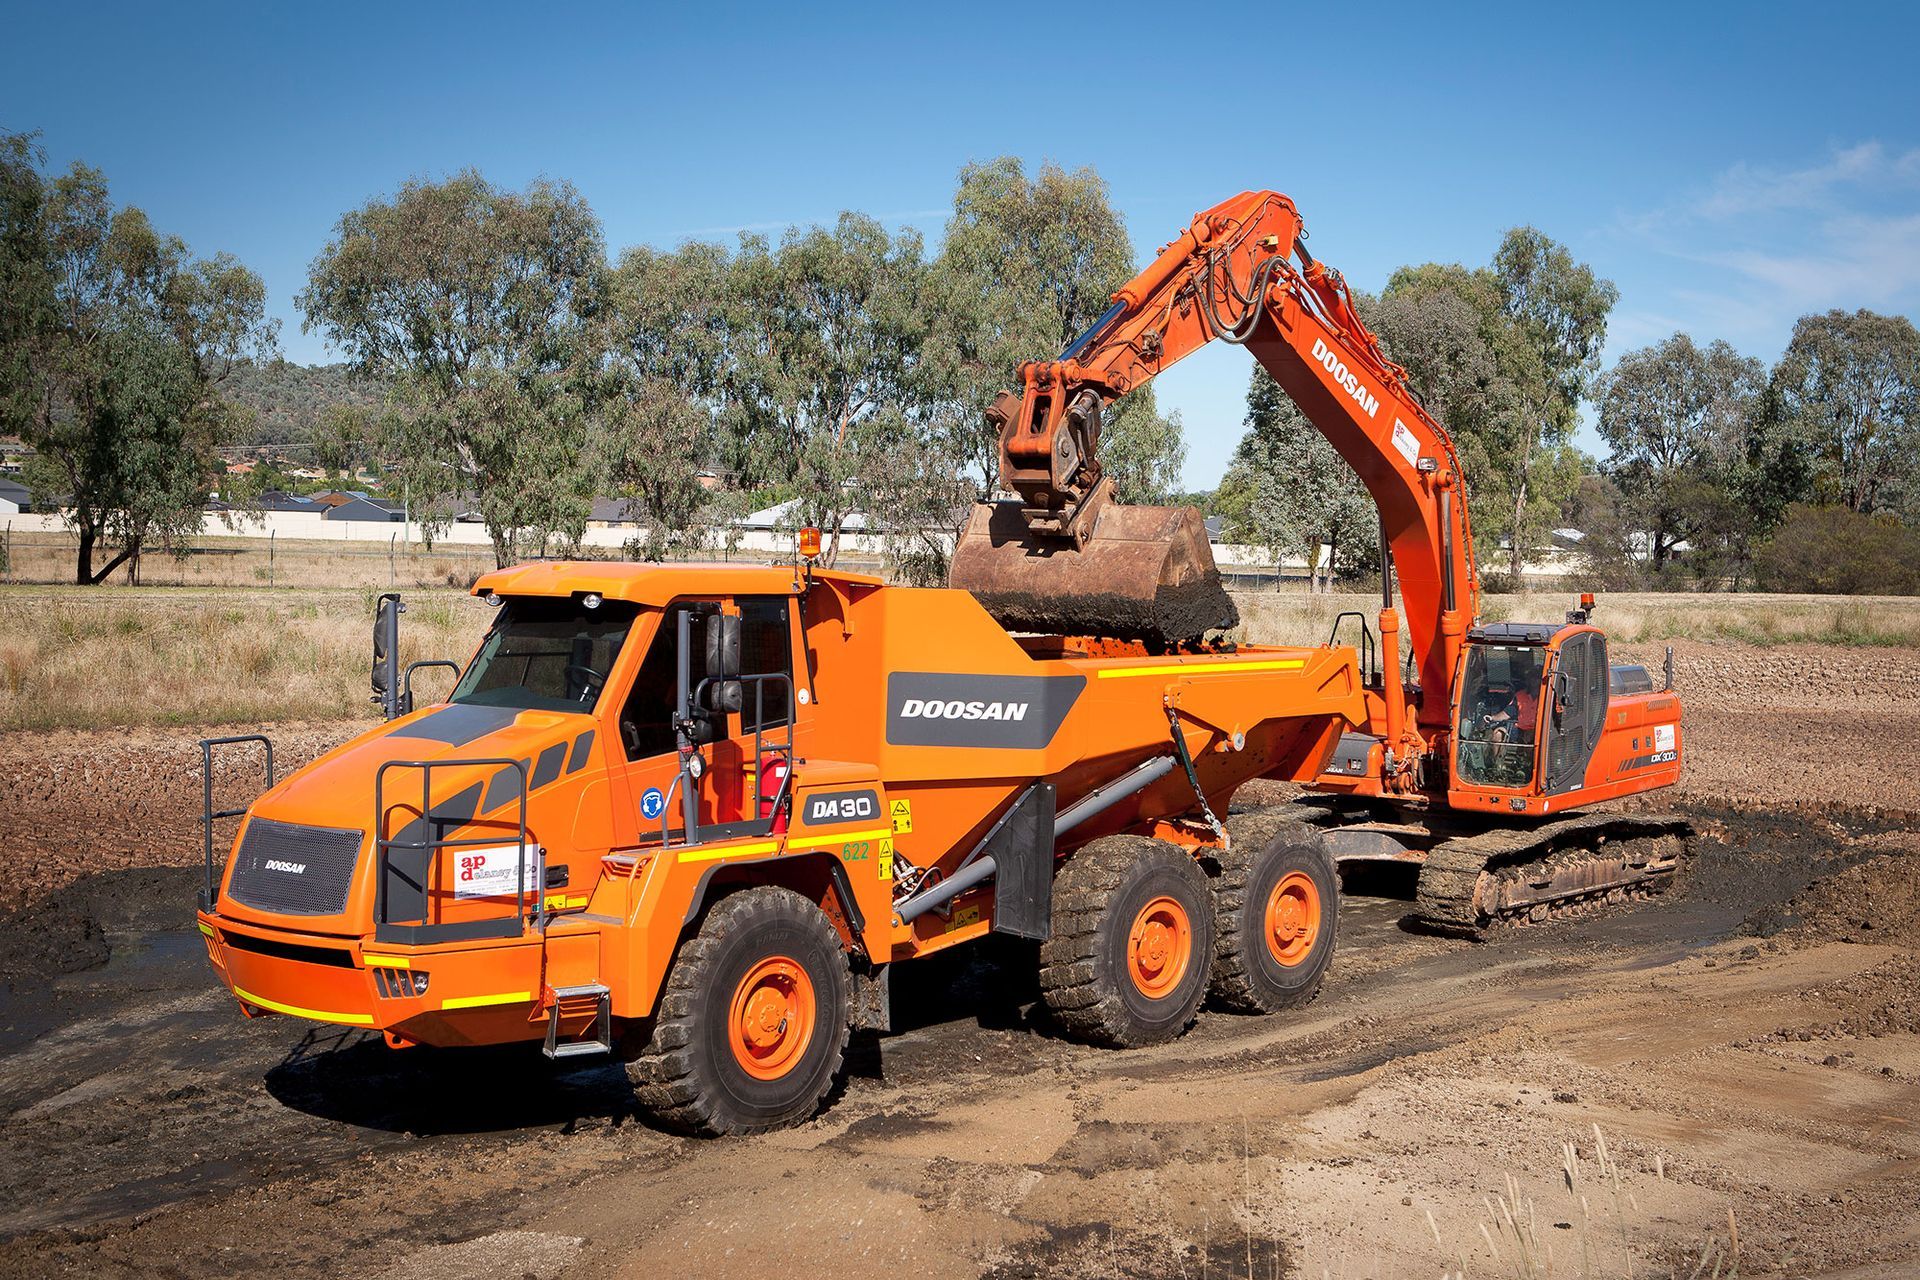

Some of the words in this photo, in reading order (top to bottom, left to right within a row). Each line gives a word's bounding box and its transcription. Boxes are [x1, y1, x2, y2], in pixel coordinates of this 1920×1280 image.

[1311, 337, 1380, 419] DOOSAN
[900, 699, 1029, 721] DOOSAN
[843, 842, 870, 861] 622
[264, 859, 307, 875] DOOSAN
[460, 855, 486, 870] ap
